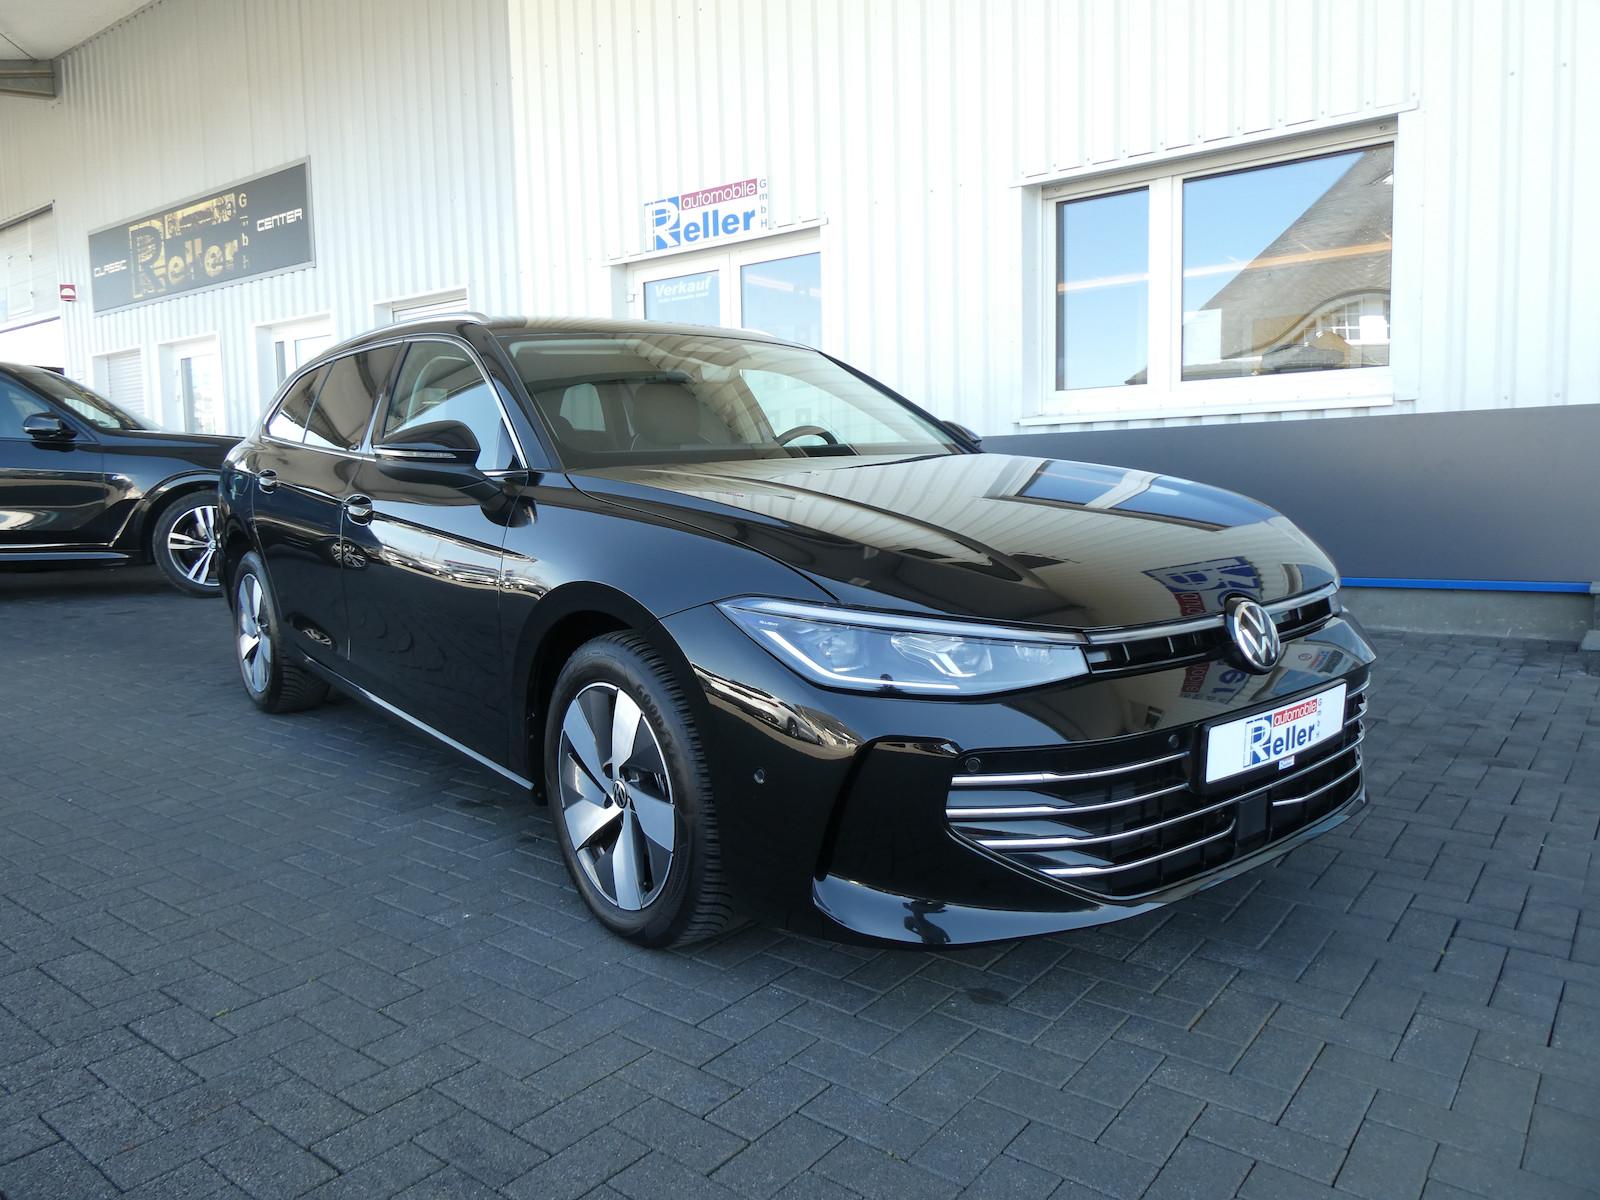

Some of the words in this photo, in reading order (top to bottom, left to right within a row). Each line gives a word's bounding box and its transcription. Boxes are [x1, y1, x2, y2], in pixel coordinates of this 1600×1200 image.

[682, 180, 757, 209] automobile
[256, 207, 303, 232] CENTER
[644, 196, 756, 252] Reller
[129, 218, 239, 299] Reller
[655, 274, 713, 297] Verkauf
[1273, 699, 1318, 727] automobile
[1243, 716, 1316, 768] Reller
